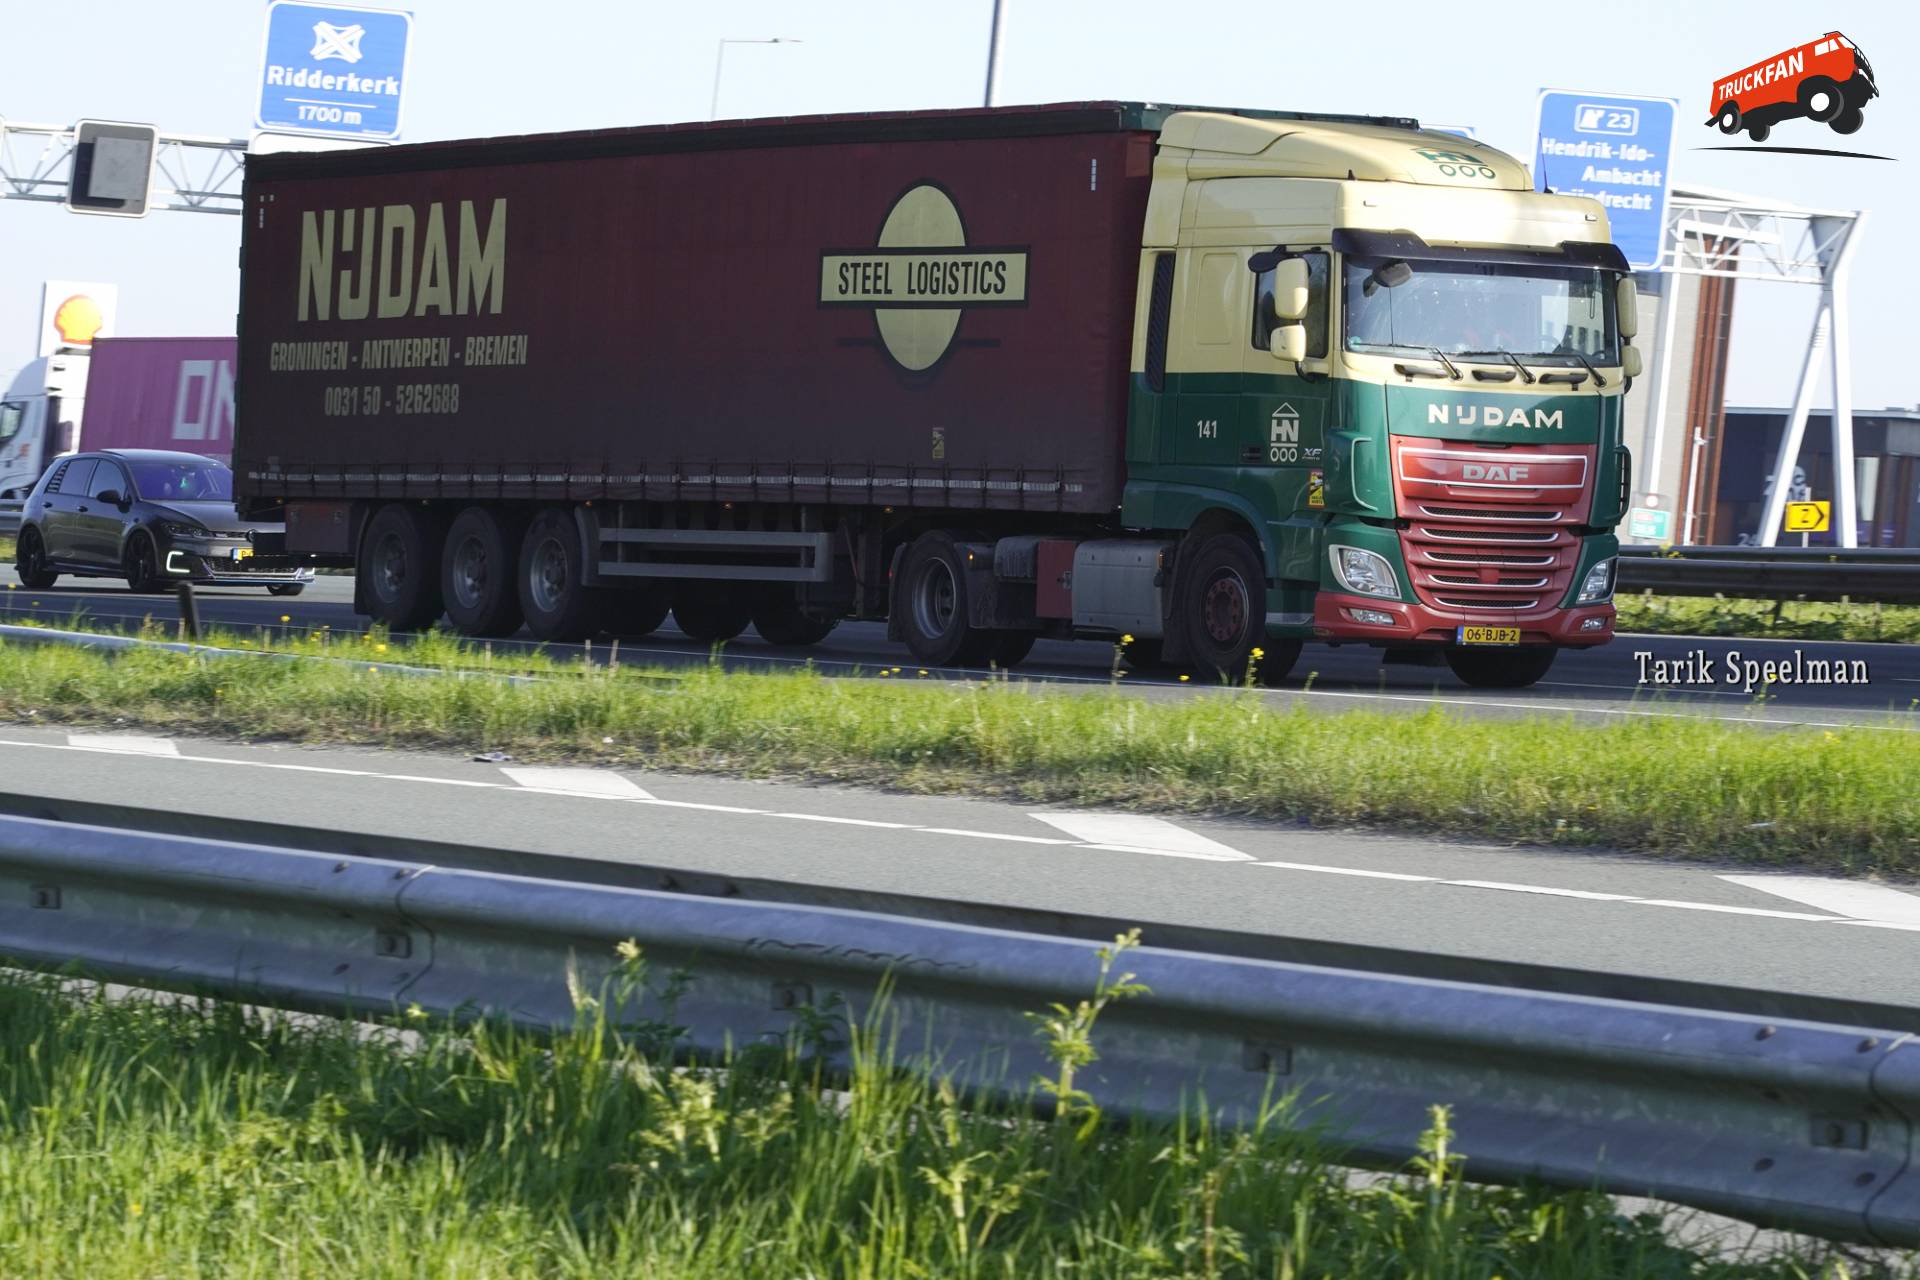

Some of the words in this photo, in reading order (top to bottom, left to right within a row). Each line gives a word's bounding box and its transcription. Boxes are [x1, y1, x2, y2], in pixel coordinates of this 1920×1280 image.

[266, 65, 400, 96] Ridderkerk
[297, 105, 342, 123] 1700
[343, 111, 362, 125] m
[1606, 113, 1632, 129] 23
[1541, 137, 1655, 161] Hendrik-Ido-
[1581, 165, 1662, 187] Ambacht
[838, 262, 893, 295] STEEL
[907, 260, 1007, 295] LOGISTICS
[270, 341, 349, 371] GRONINGEN
[361, 337, 451, 369] ANTWERPEN
[464, 335, 528, 366] BREMEN
[324, 386, 358, 416] 0031
[362, 386, 381, 415] 50
[395, 384, 460, 415] 5262688
[1197, 420, 1217, 439] 141
[1270, 419, 1299, 442] HN
[1303, 448, 1322, 456] XF
[1463, 464, 1529, 482] DAF
